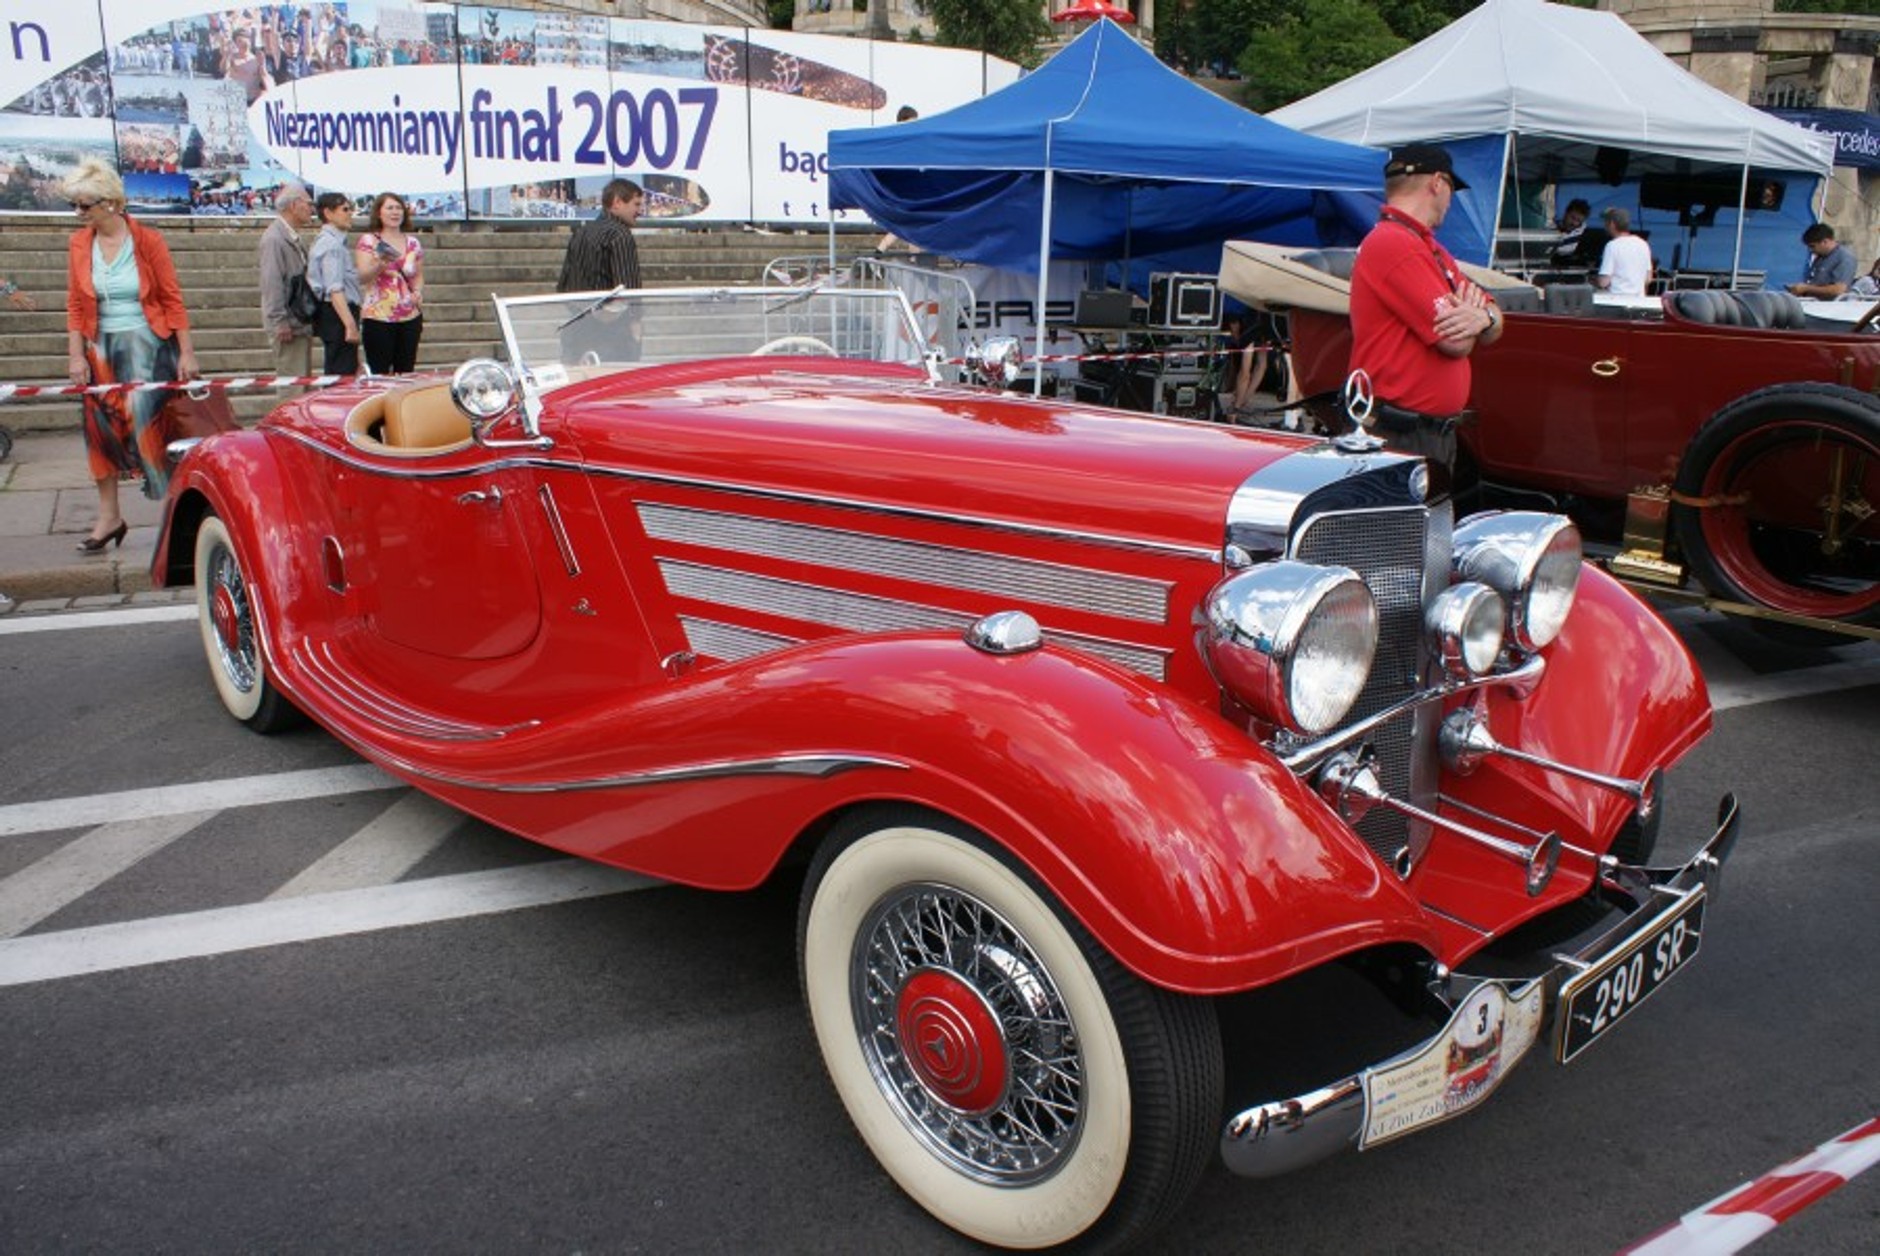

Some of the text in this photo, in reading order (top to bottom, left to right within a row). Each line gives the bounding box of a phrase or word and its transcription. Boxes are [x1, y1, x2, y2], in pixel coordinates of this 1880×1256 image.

[265, 86, 719, 175] Niezapomniany finał 2007
[1477, 1002, 1489, 1036] 3
[1591, 918, 1686, 1035] 290 SR
